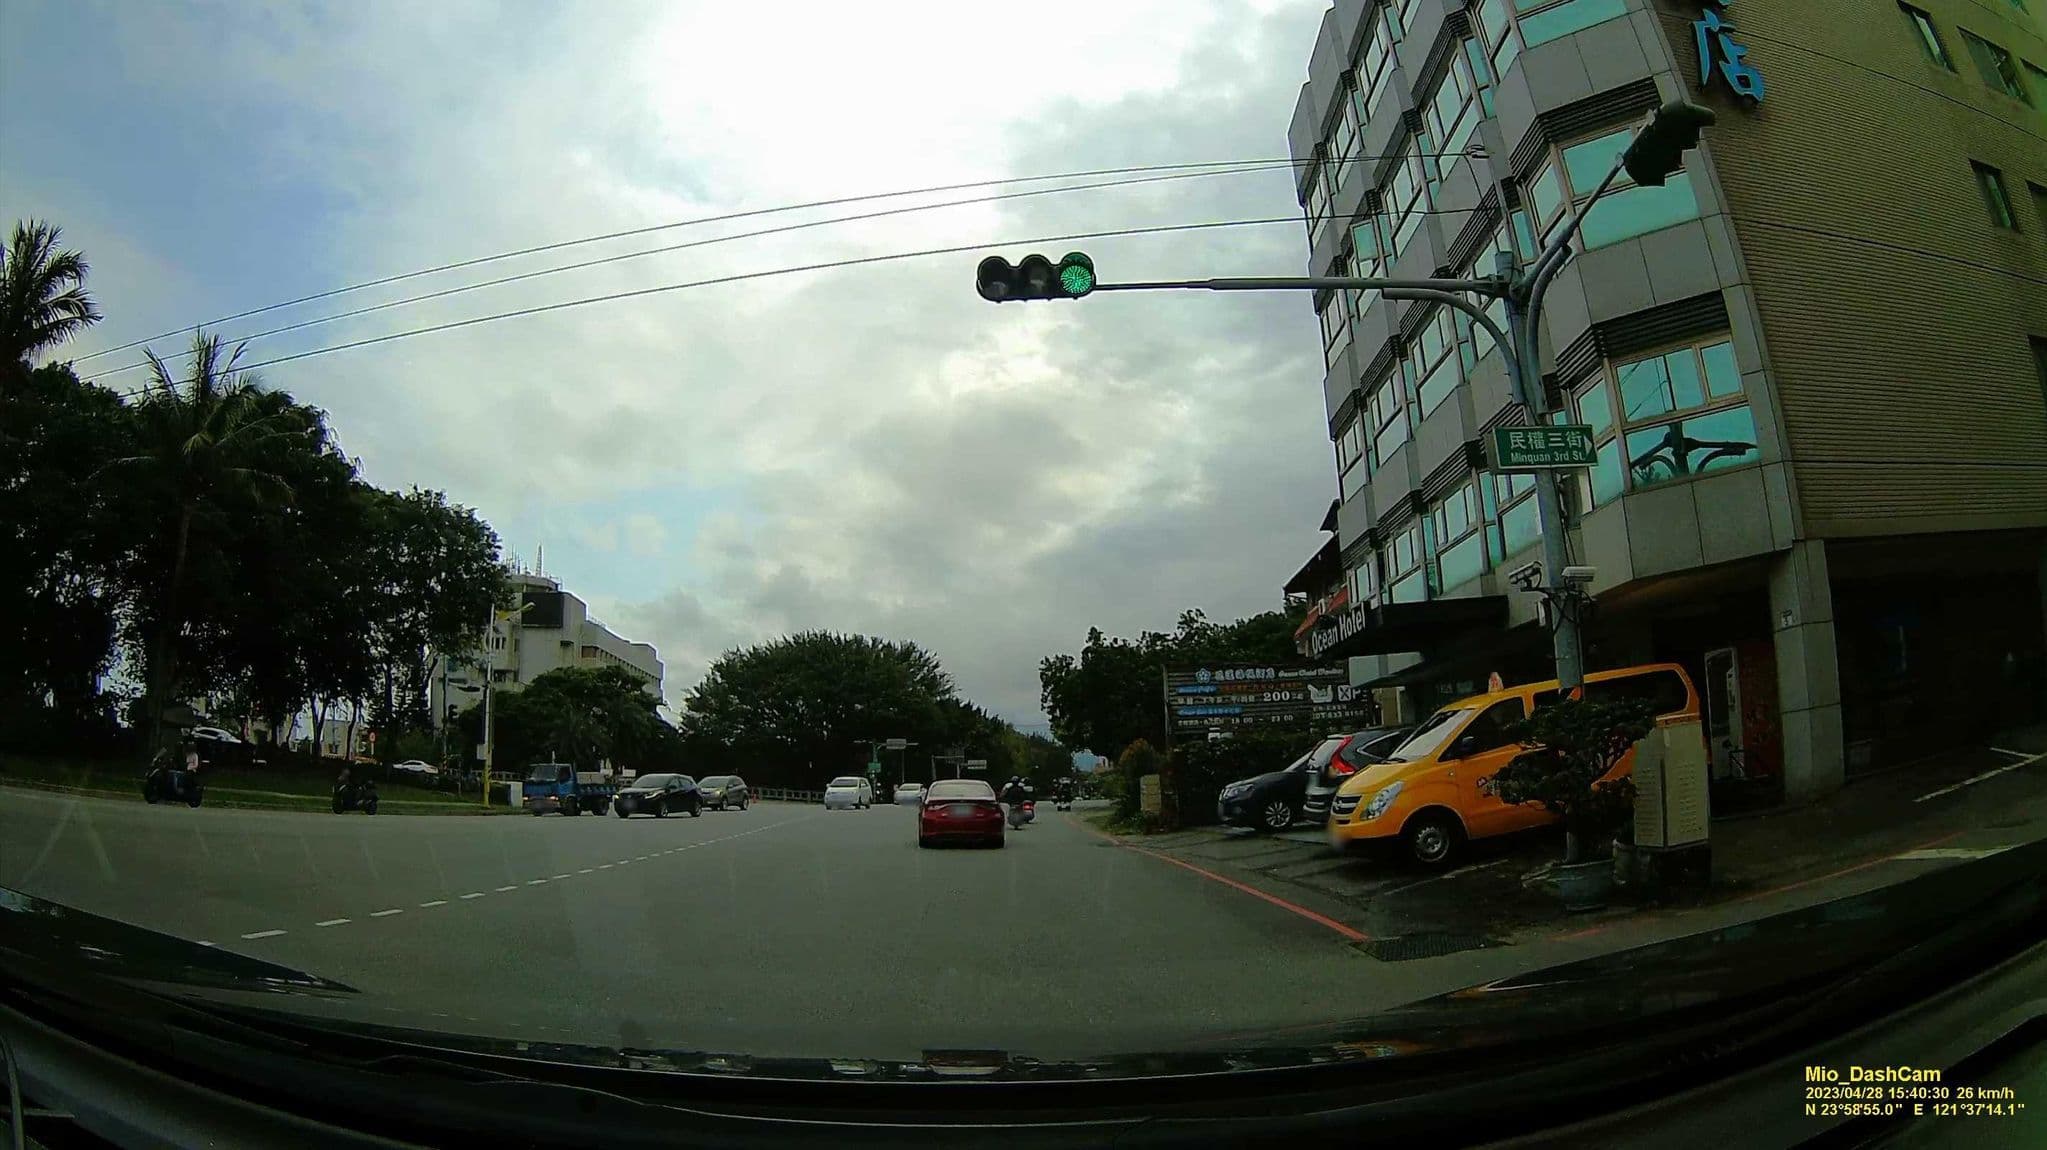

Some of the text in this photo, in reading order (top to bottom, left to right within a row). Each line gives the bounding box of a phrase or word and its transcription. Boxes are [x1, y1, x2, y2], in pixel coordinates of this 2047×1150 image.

[1693, 8, 1766, 102] 店
[1509, 431, 1582, 450] 民權三街
[1511, 452, 1551, 464] Minquan
[1554, 451, 1569, 462] 3rd
[1312, 602, 1366, 655] Ocean Hotel
[1263, 691, 1290, 702] 200
